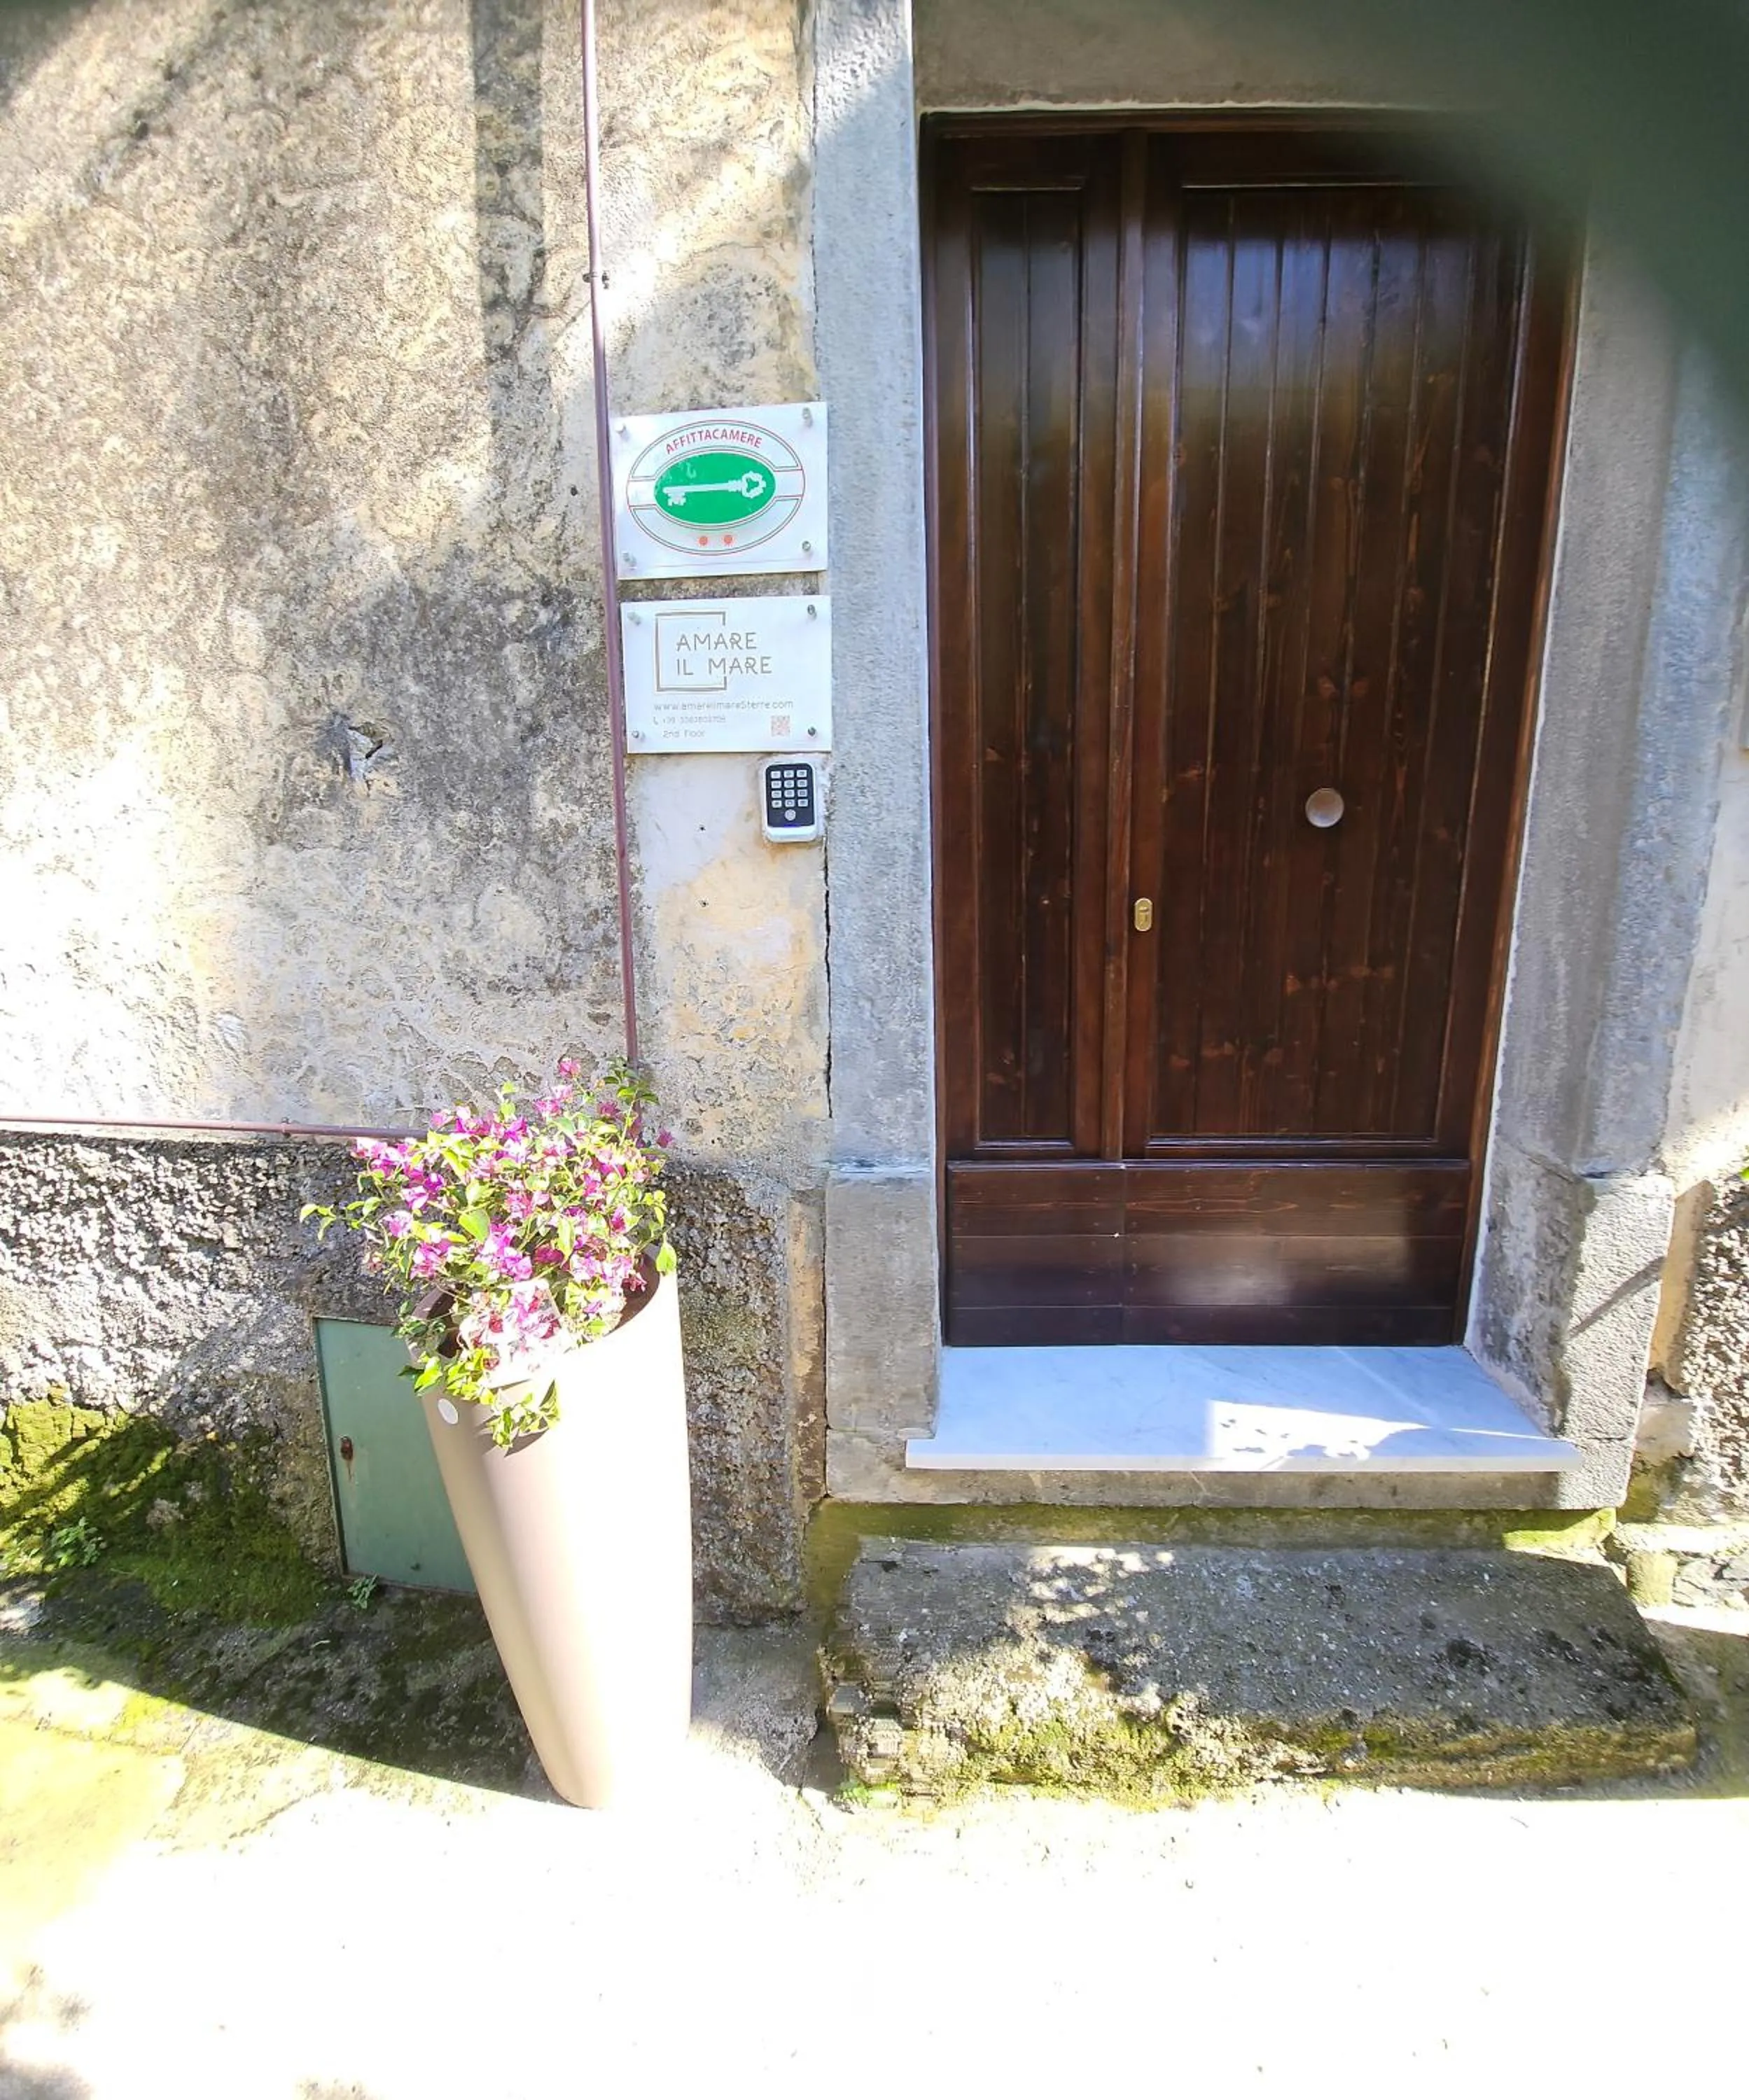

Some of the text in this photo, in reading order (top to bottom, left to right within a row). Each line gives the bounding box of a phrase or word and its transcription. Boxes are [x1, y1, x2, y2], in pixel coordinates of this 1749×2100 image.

[666, 428, 762, 454] AFFITTACAMERE
[676, 631, 758, 652] AMARE
[676, 657, 772, 676] IL MARE
[662, 729, 680, 738] 2nd
